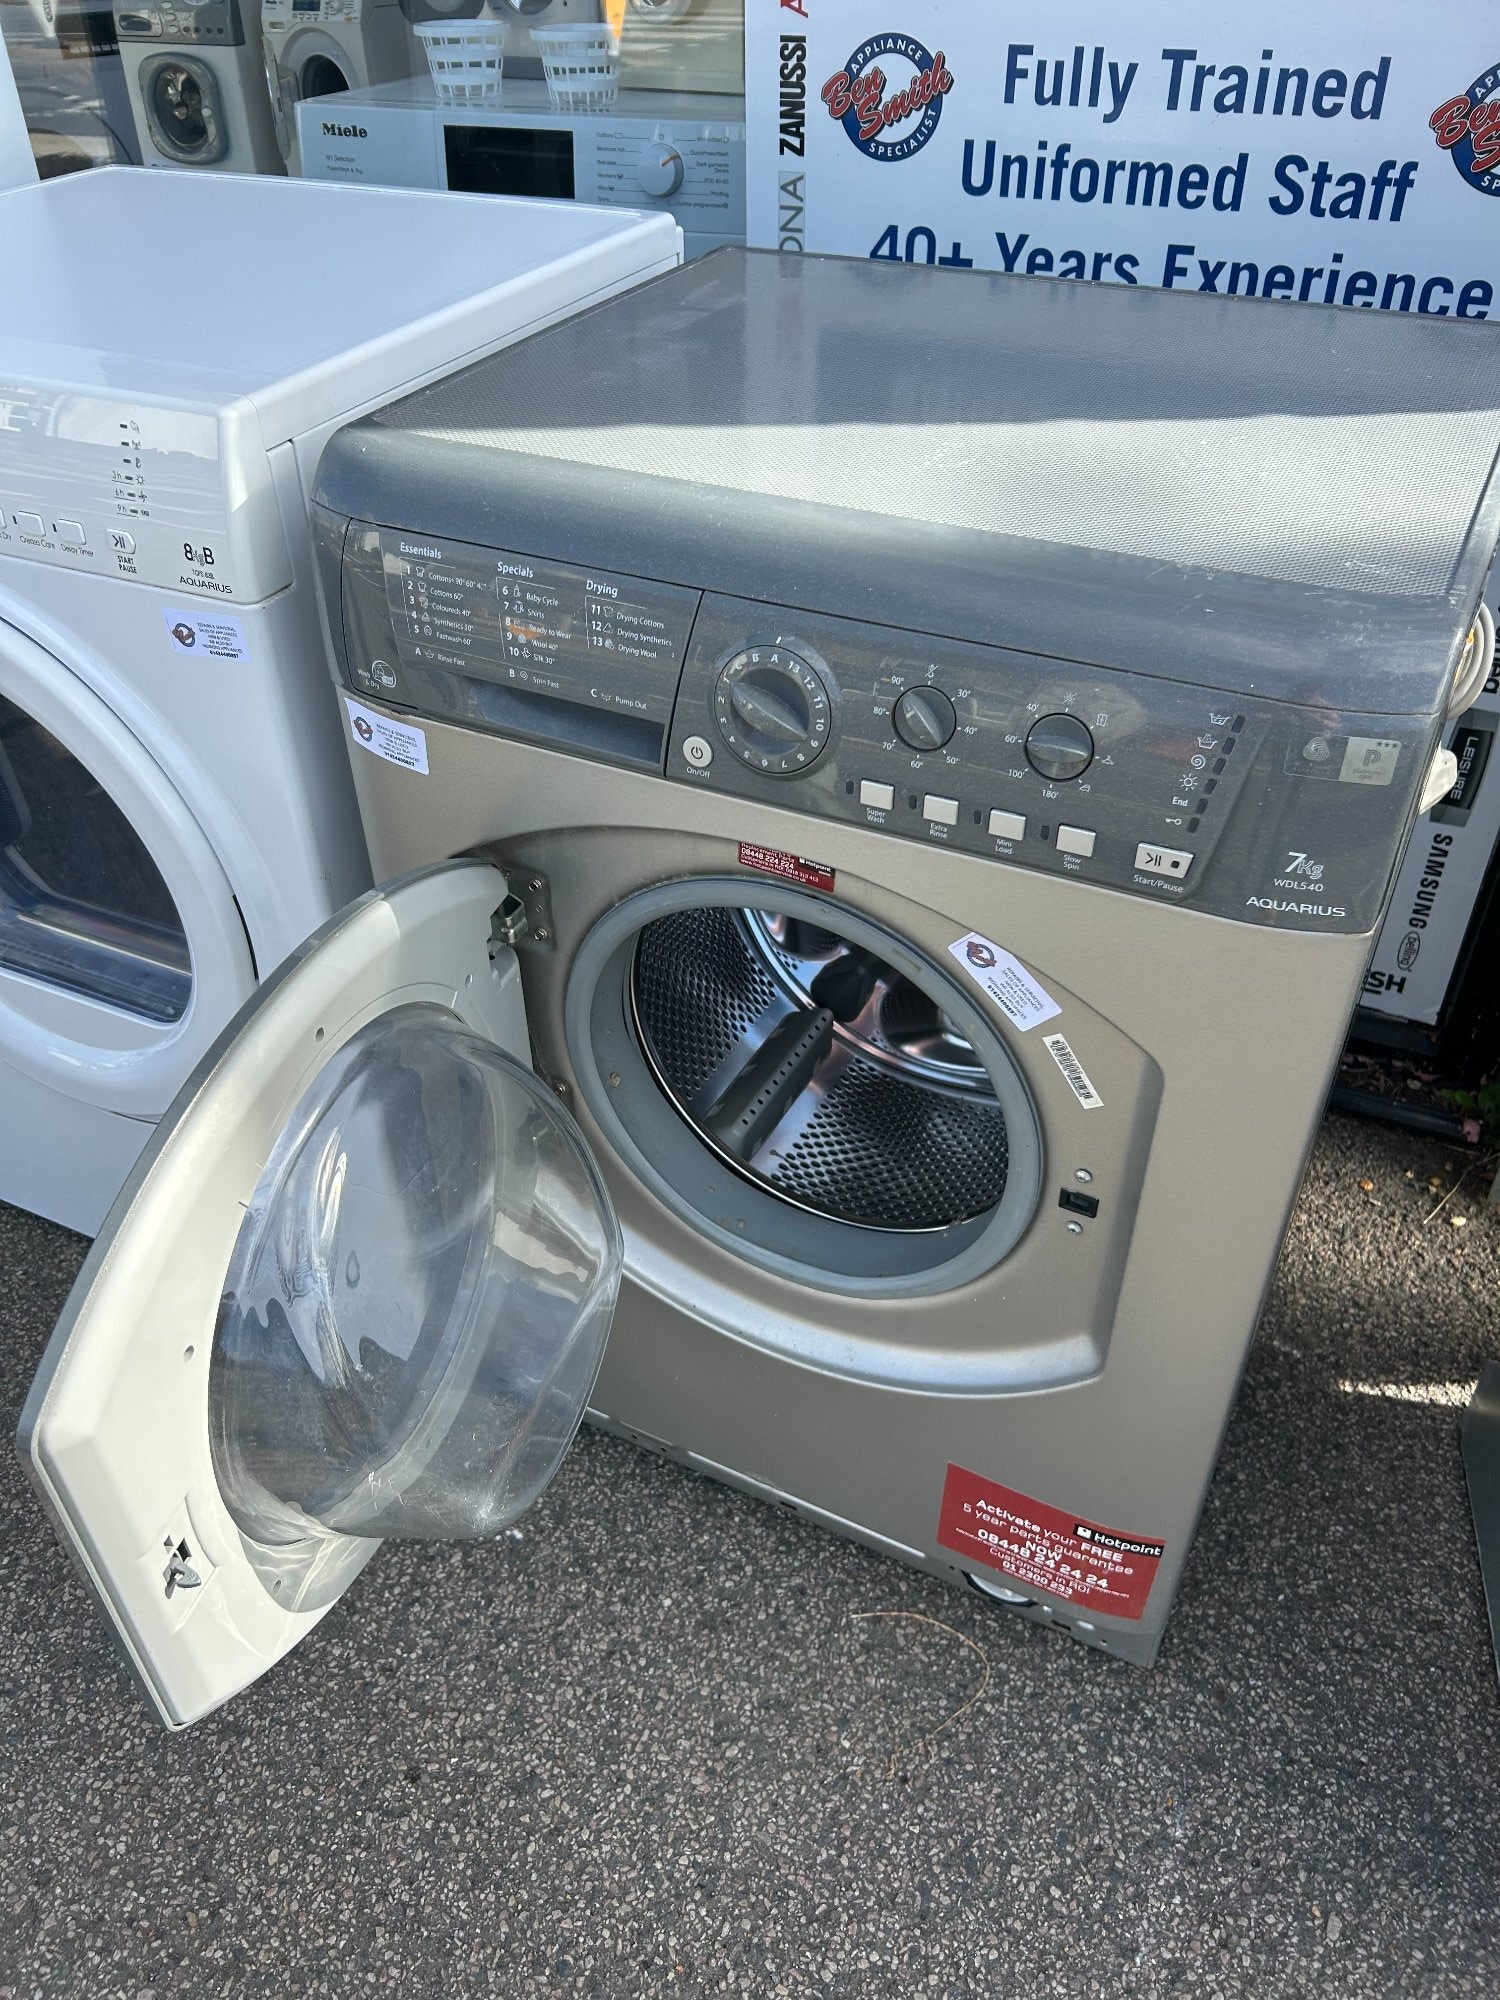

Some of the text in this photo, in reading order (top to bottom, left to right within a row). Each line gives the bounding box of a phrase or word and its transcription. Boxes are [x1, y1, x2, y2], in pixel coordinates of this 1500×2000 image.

[851, 38, 923, 74] APPLIANCE
[1003, 43, 1392, 123] Fully Trained
[779, 35, 806, 157] ZANUSSI
[821, 67, 887, 120] Ben
[857, 51, 954, 140] Smith
[322, 122, 368, 138] Miele
[869, 108, 936, 157] SPECIALIST
[961, 139, 1420, 222] Uniformed Staff
[869, 225, 1493, 320] 40+ Years Experience
[61, 543, 78, 555] Delay
[400, 541, 442, 559] Essentials
[117, 555, 134, 565] START
[118, 563, 138, 574] PAUSE
[406, 565, 411, 574] 1
[497, 561, 534, 578] Specials
[180, 576, 233, 594] AQUARIUS
[408, 581, 413, 590] 2
[430, 588, 453, 599] Cottons
[585, 579, 619, 598] Drying
[409, 596, 415, 605] 3
[432, 602, 460, 615] Coloureds
[502, 586, 559, 607] 6 Baby Cycle
[504, 601, 545, 619] 7 Shirts
[591, 604, 665, 630] 11 Drying Cottons
[411, 611, 417, 619] 4
[434, 618, 463, 631] Synthetics
[414, 625, 420, 634] 5
[505, 617, 511, 626] 8
[528, 624, 547, 635] Ready
[556, 632, 571, 640] Wear
[507, 632, 512, 641] 9
[531, 639, 548, 649] Wool
[591, 620, 673, 647] 12 Drying Synthetics
[509, 646, 519, 656] 10
[533, 653, 544, 663] Silk
[592, 636, 657, 659] 13 Drying Wool
[415, 647, 466, 667] A Rinse Fast
[752, 653, 759, 663] B
[771, 654, 779, 663] A
[788, 661, 801, 674] 13
[370, 680, 380, 689] Dry
[509, 669, 560, 689] B Spin Fast
[803, 676, 815, 690] 12
[590, 688, 647, 710] C Pump Out
[813, 696, 823, 709] 11
[815, 718, 824, 731] 10
[686, 766, 711, 779] On/Off
[1449, 736, 1480, 801] LEISURE
[1171, 796, 1189, 807] End
[866, 807, 886, 817] Super
[866, 814, 885, 824] Wash
[929, 829, 948, 839] Rinse
[930, 822, 948, 833] Extra
[995, 845, 1013, 855] Load
[997, 839, 1013, 848] Mini
[741, 847, 764, 860] 08448
[765, 856, 778, 864] 224
[780, 860, 794, 870] 224
[806, 860, 832, 873] Hotpoint
[1063, 854, 1082, 864] Slow
[1063, 861, 1080, 871] Spin
[1133, 873, 1185, 894] Start/Pause
[1272, 878, 1324, 893] WDL540
[1408, 832, 1453, 929] SAMSUNG
[1246, 896, 1346, 918] AQUARIUS
[963, 1502, 1134, 1575] 5 year parts guarantee
[976, 1500, 1123, 1563] Activate your FREE
[1026, 1541, 1062, 1562] NOW
[1095, 1532, 1161, 1556] Hotpoint
[977, 1528, 1031, 1559] 08448
[1034, 1553, 1056, 1568] 24
[1060, 1564, 1082, 1579] 24
[1086, 1574, 1108, 1588] 24
[989, 1547, 1053, 1580] Customers
[1055, 1577, 1066, 1585] in
[1069, 1580, 1090, 1594] ROI
[1002, 1560, 1016, 1572] 01
[1019, 1568, 1048, 1585] 2300
[1050, 1580, 1073, 1595] 233
